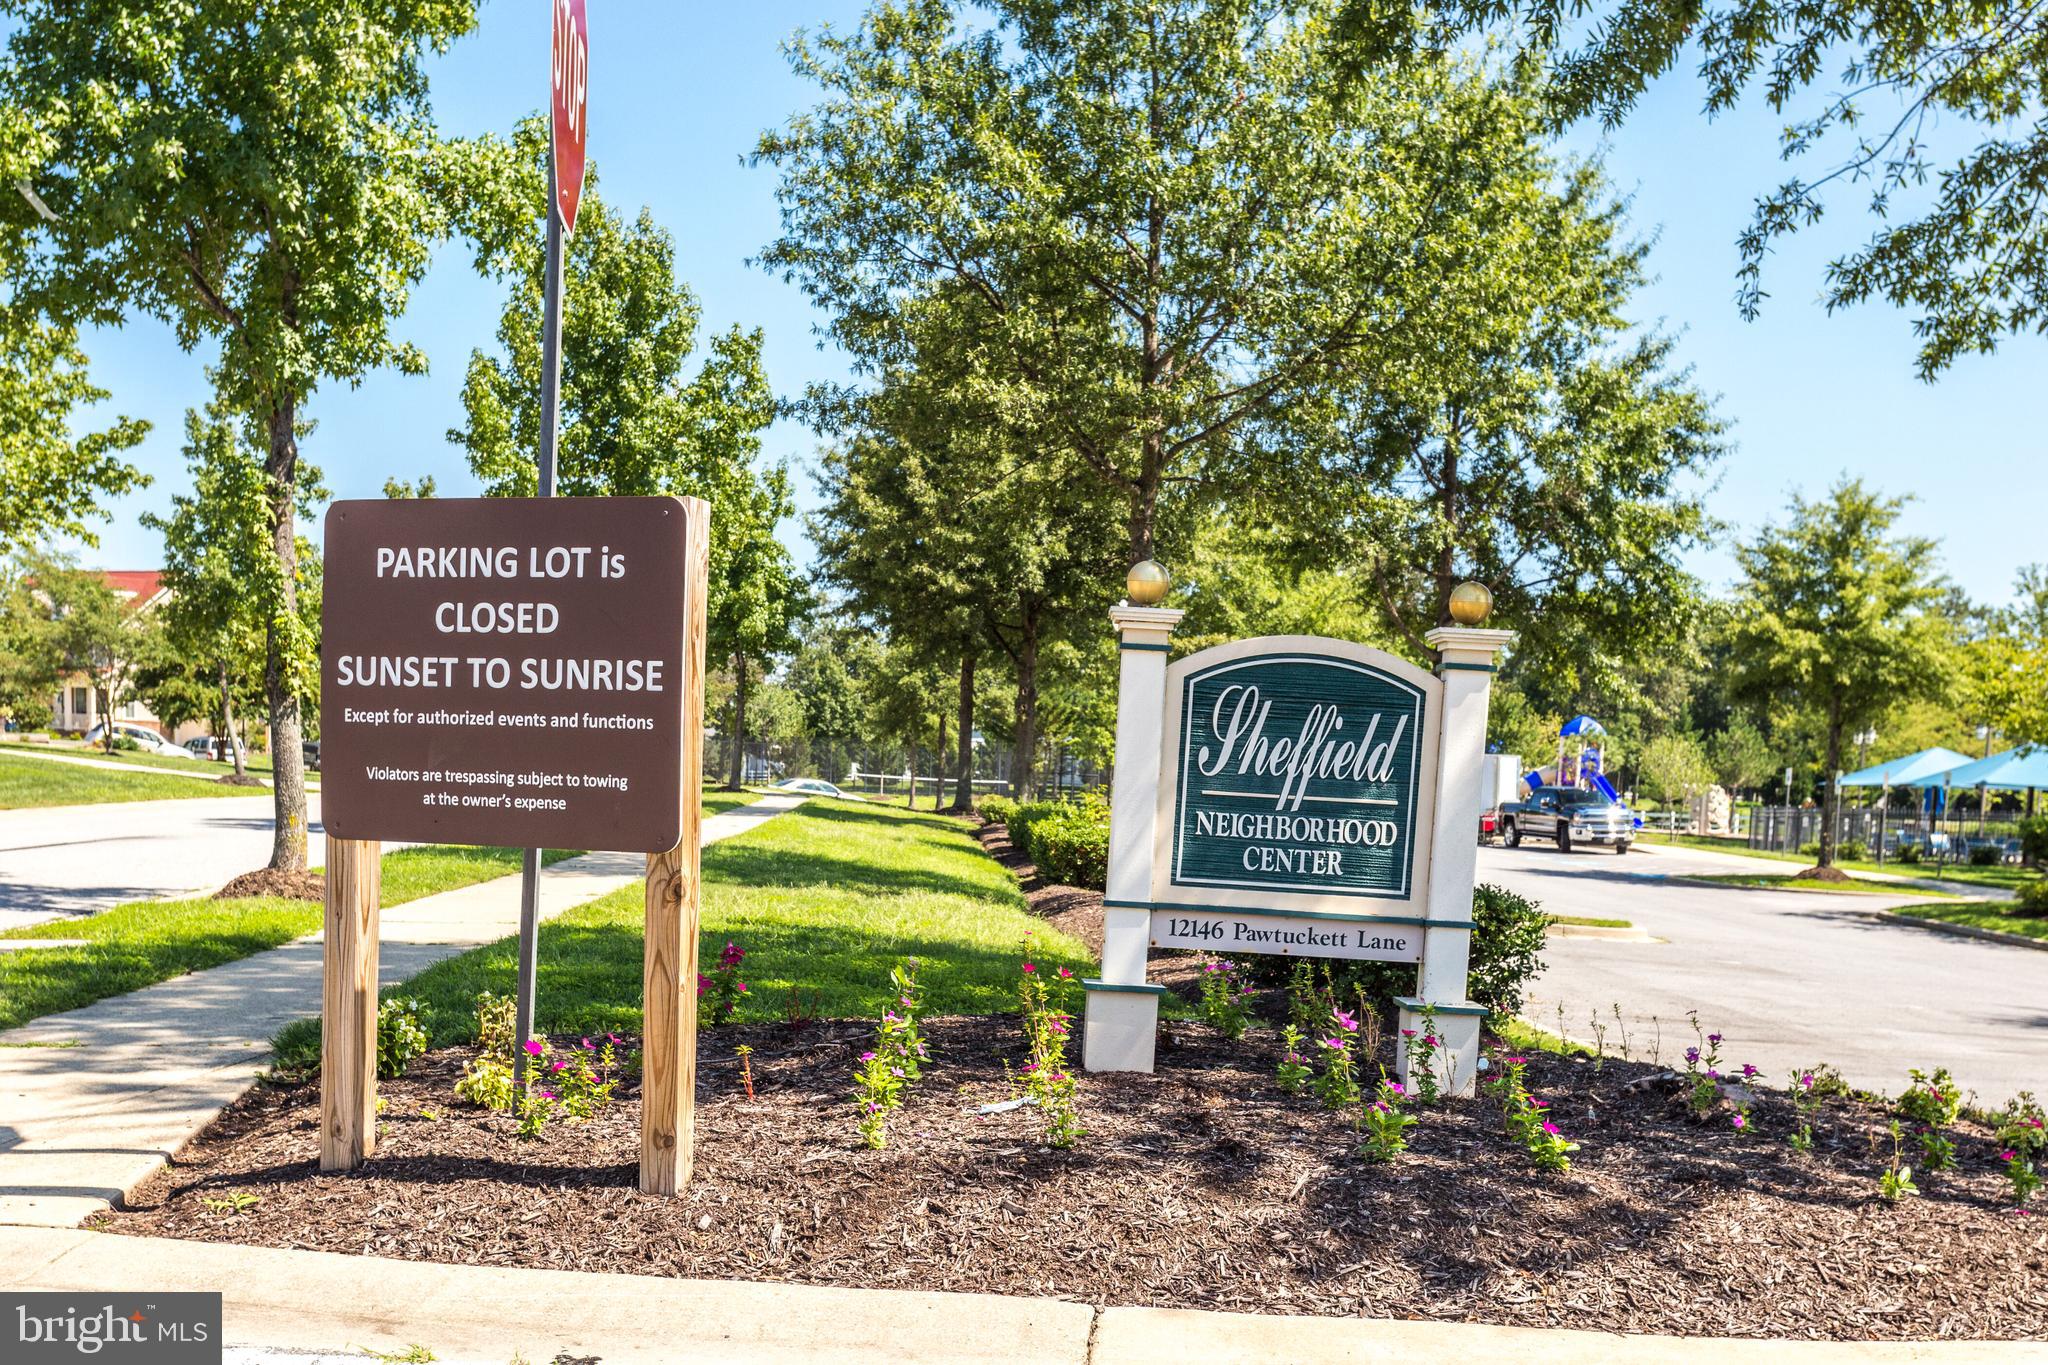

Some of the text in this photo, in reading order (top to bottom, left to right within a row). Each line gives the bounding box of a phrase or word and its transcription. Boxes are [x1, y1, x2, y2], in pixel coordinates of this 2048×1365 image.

[553, 0, 585, 144] STOP
[377, 546, 625, 579] PARKING LOT is
[435, 602, 559, 634] CLOSED
[337, 656, 664, 692] SUNSET TO SUNRISE
[344, 708, 654, 730] Except for authorized events and functions
[1198, 685, 1409, 812] Sheffield
[367, 767, 628, 791] Violators are trespassing subject to towing
[423, 793, 566, 812] at the owner's expense
[1195, 811, 1398, 846] NEIGHBORHOOD
[1243, 847, 1343, 876] CENTER
[1168, 918, 1406, 950] 12146 Pawtuckett Lane
